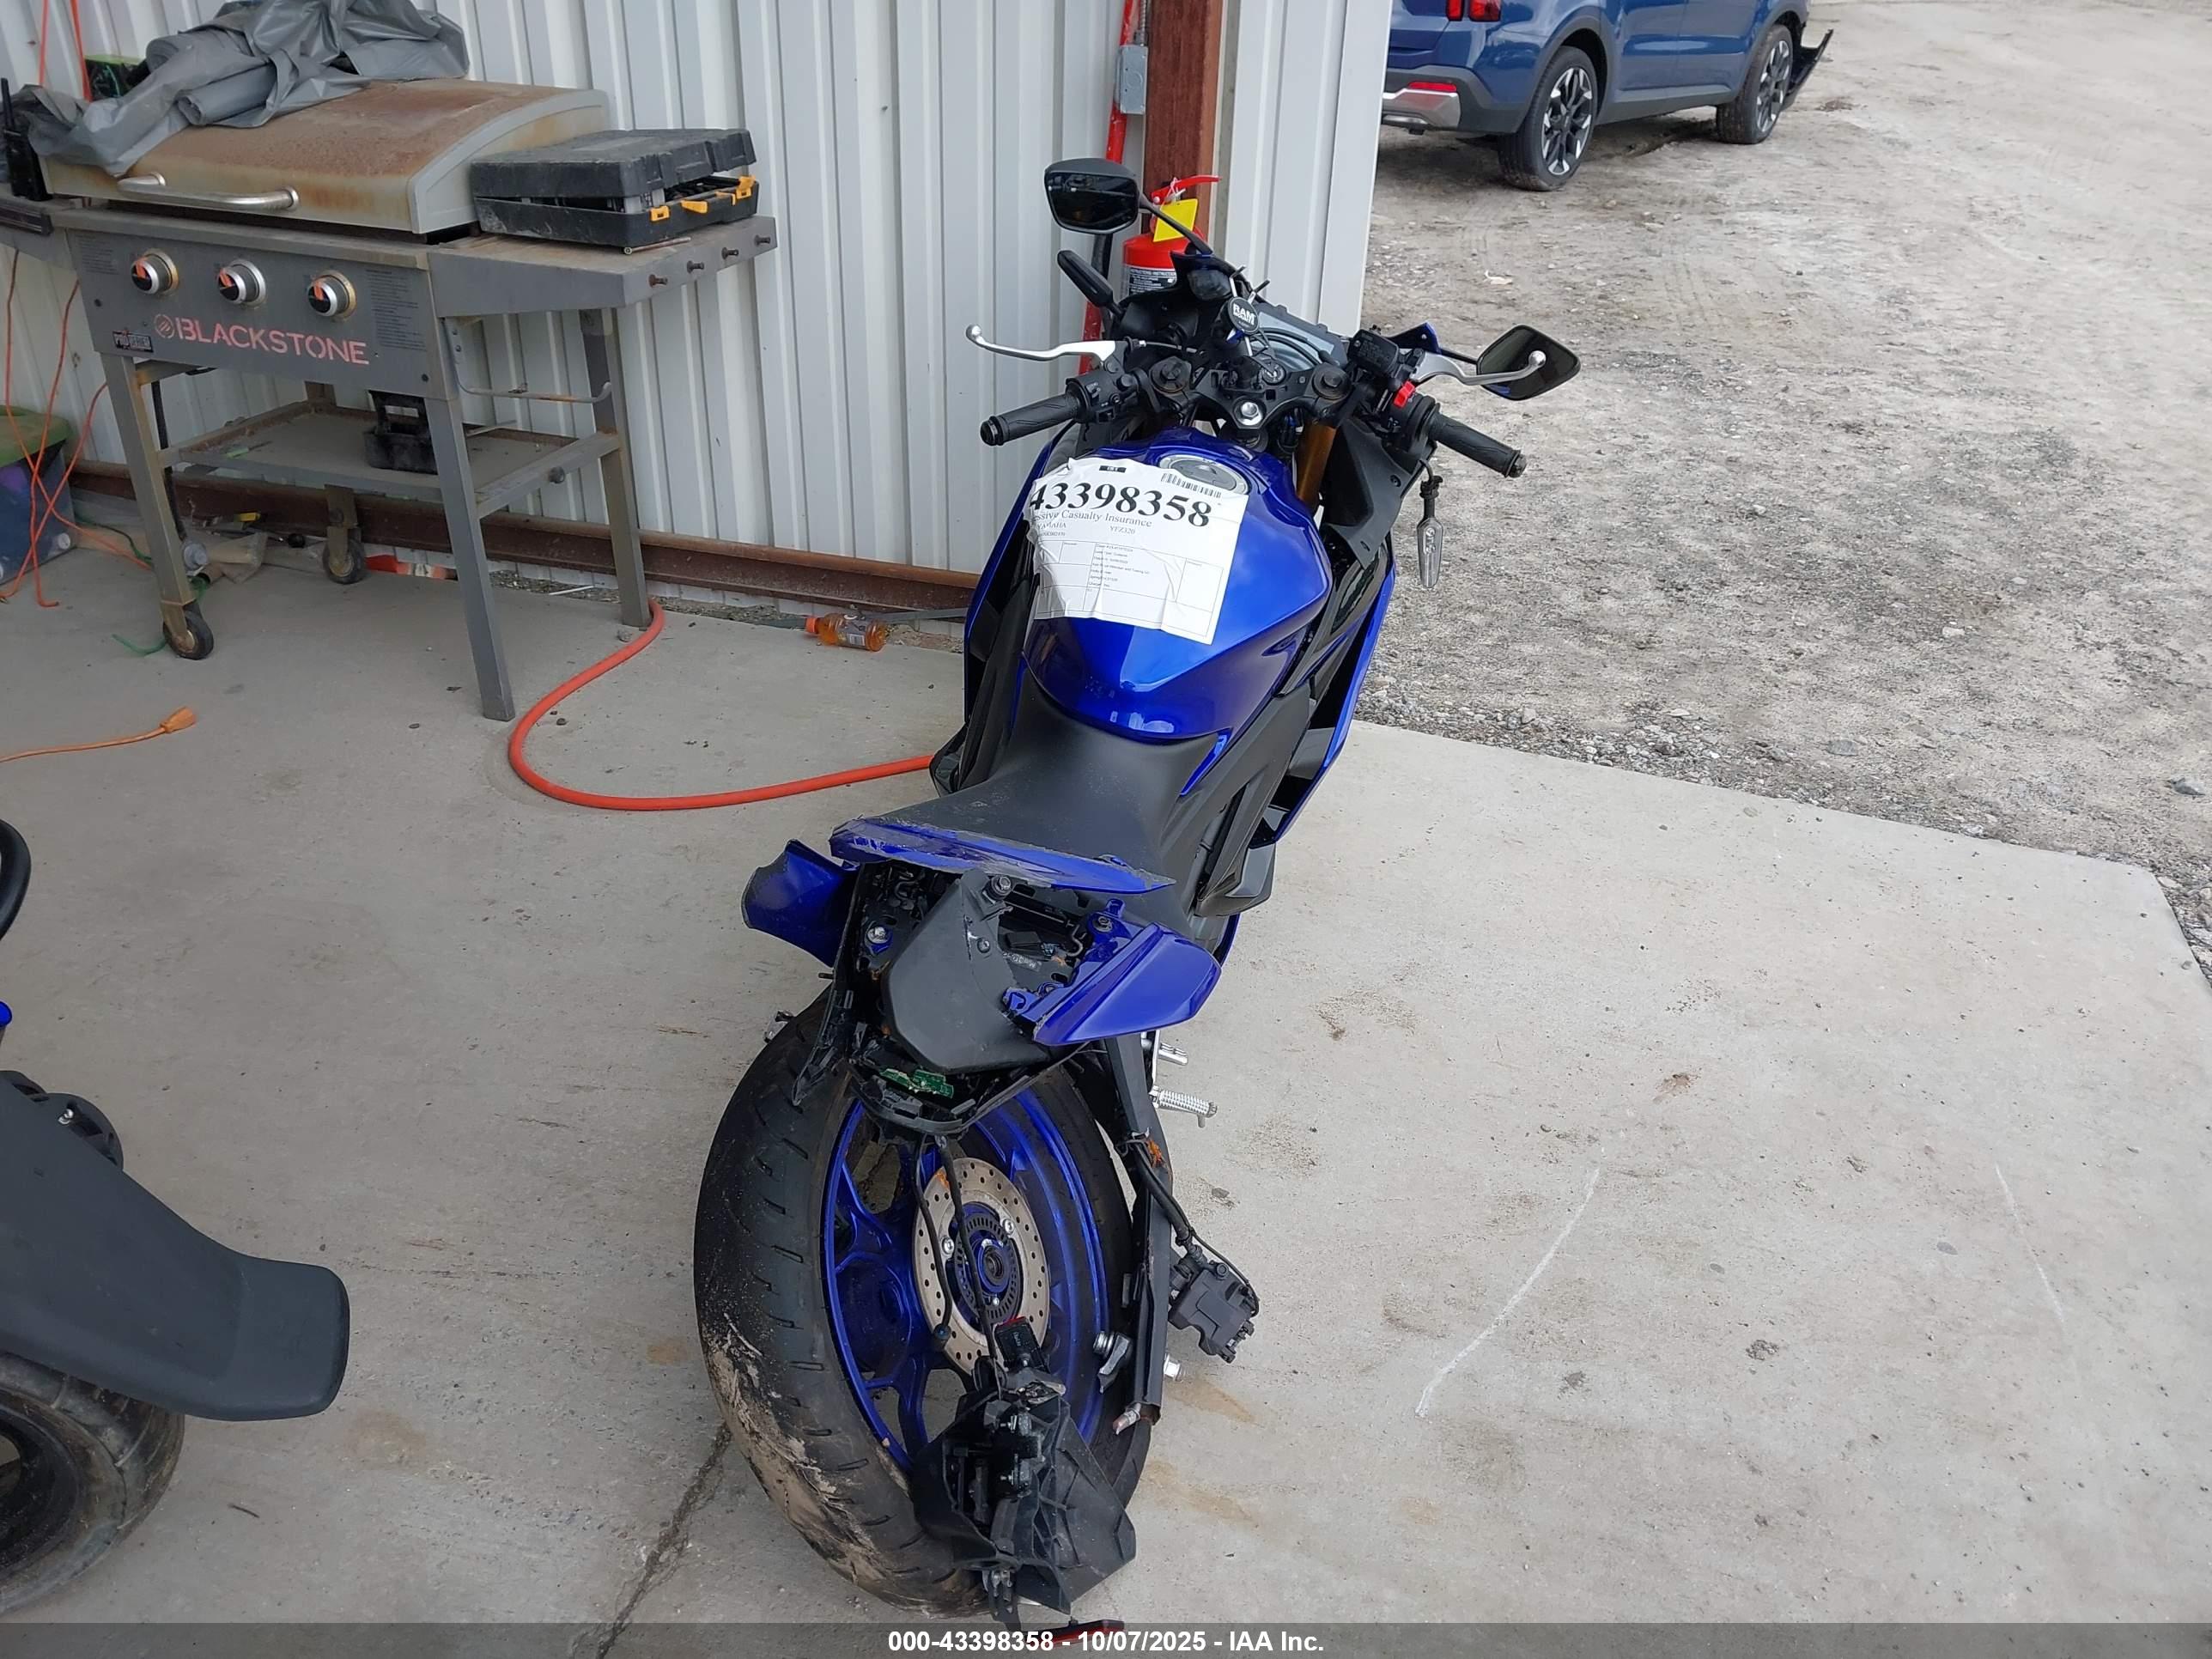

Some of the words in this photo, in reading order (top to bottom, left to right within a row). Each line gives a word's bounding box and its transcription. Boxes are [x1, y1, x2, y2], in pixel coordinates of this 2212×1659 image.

[175, 317, 369, 365] BLACKSTONE
[1030, 483, 1212, 526] 43398358
[1061, 509, 1103, 522] Casualty
[1105, 513, 1153, 527] Insurance
